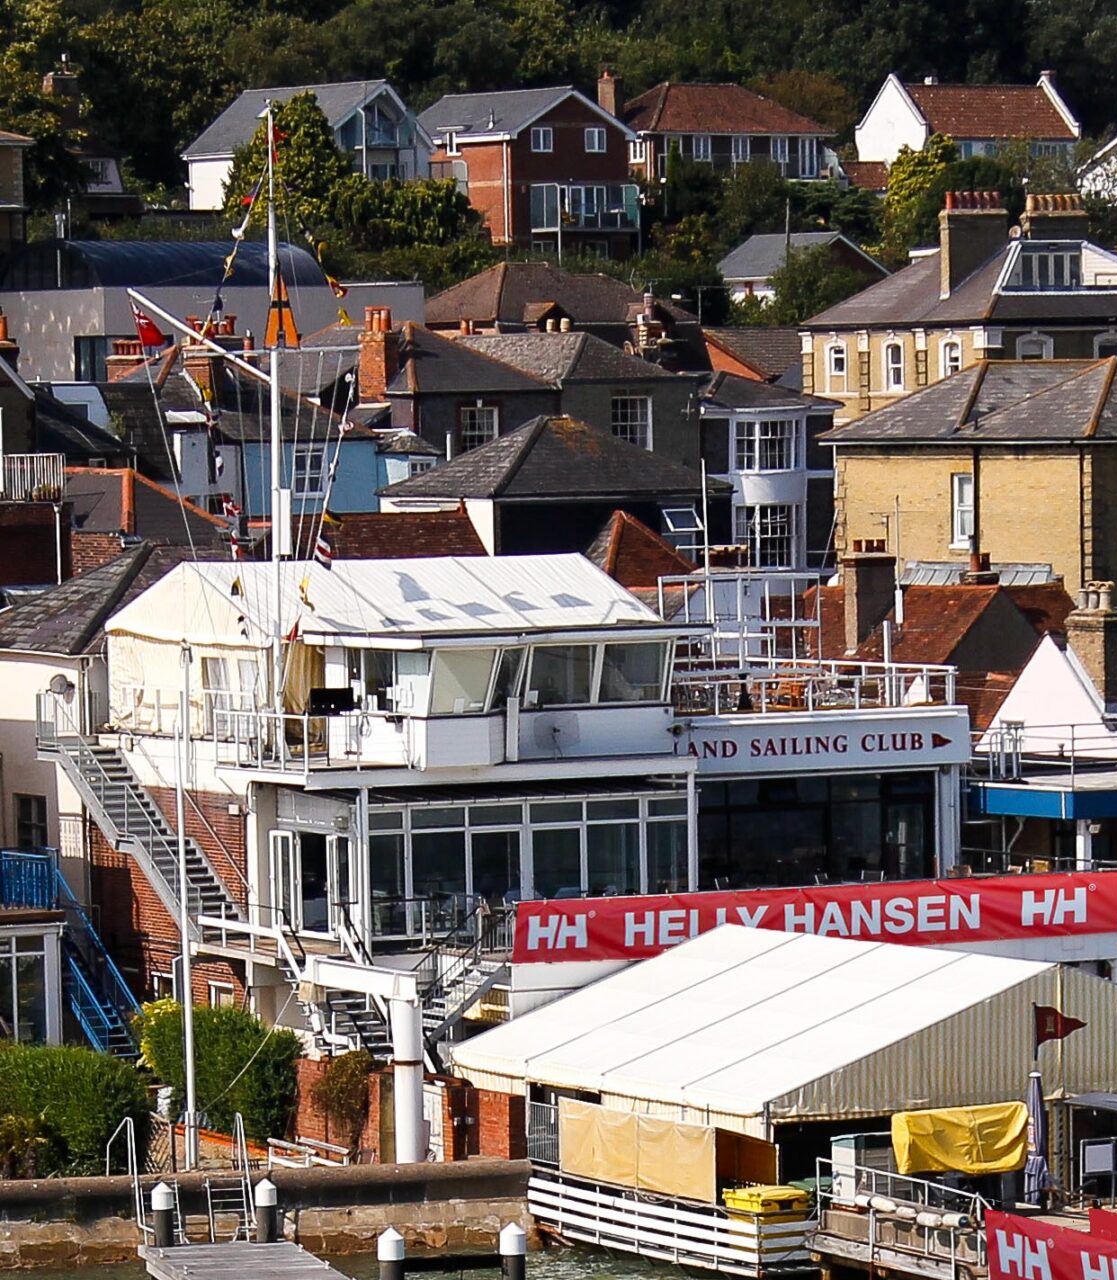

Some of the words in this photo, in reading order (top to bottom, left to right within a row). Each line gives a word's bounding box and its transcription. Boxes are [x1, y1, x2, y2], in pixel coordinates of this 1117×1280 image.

[750, 734, 849, 757] SAILING
[860, 732, 924, 752] CLUB
[784, 893, 981, 937] HANSEN
